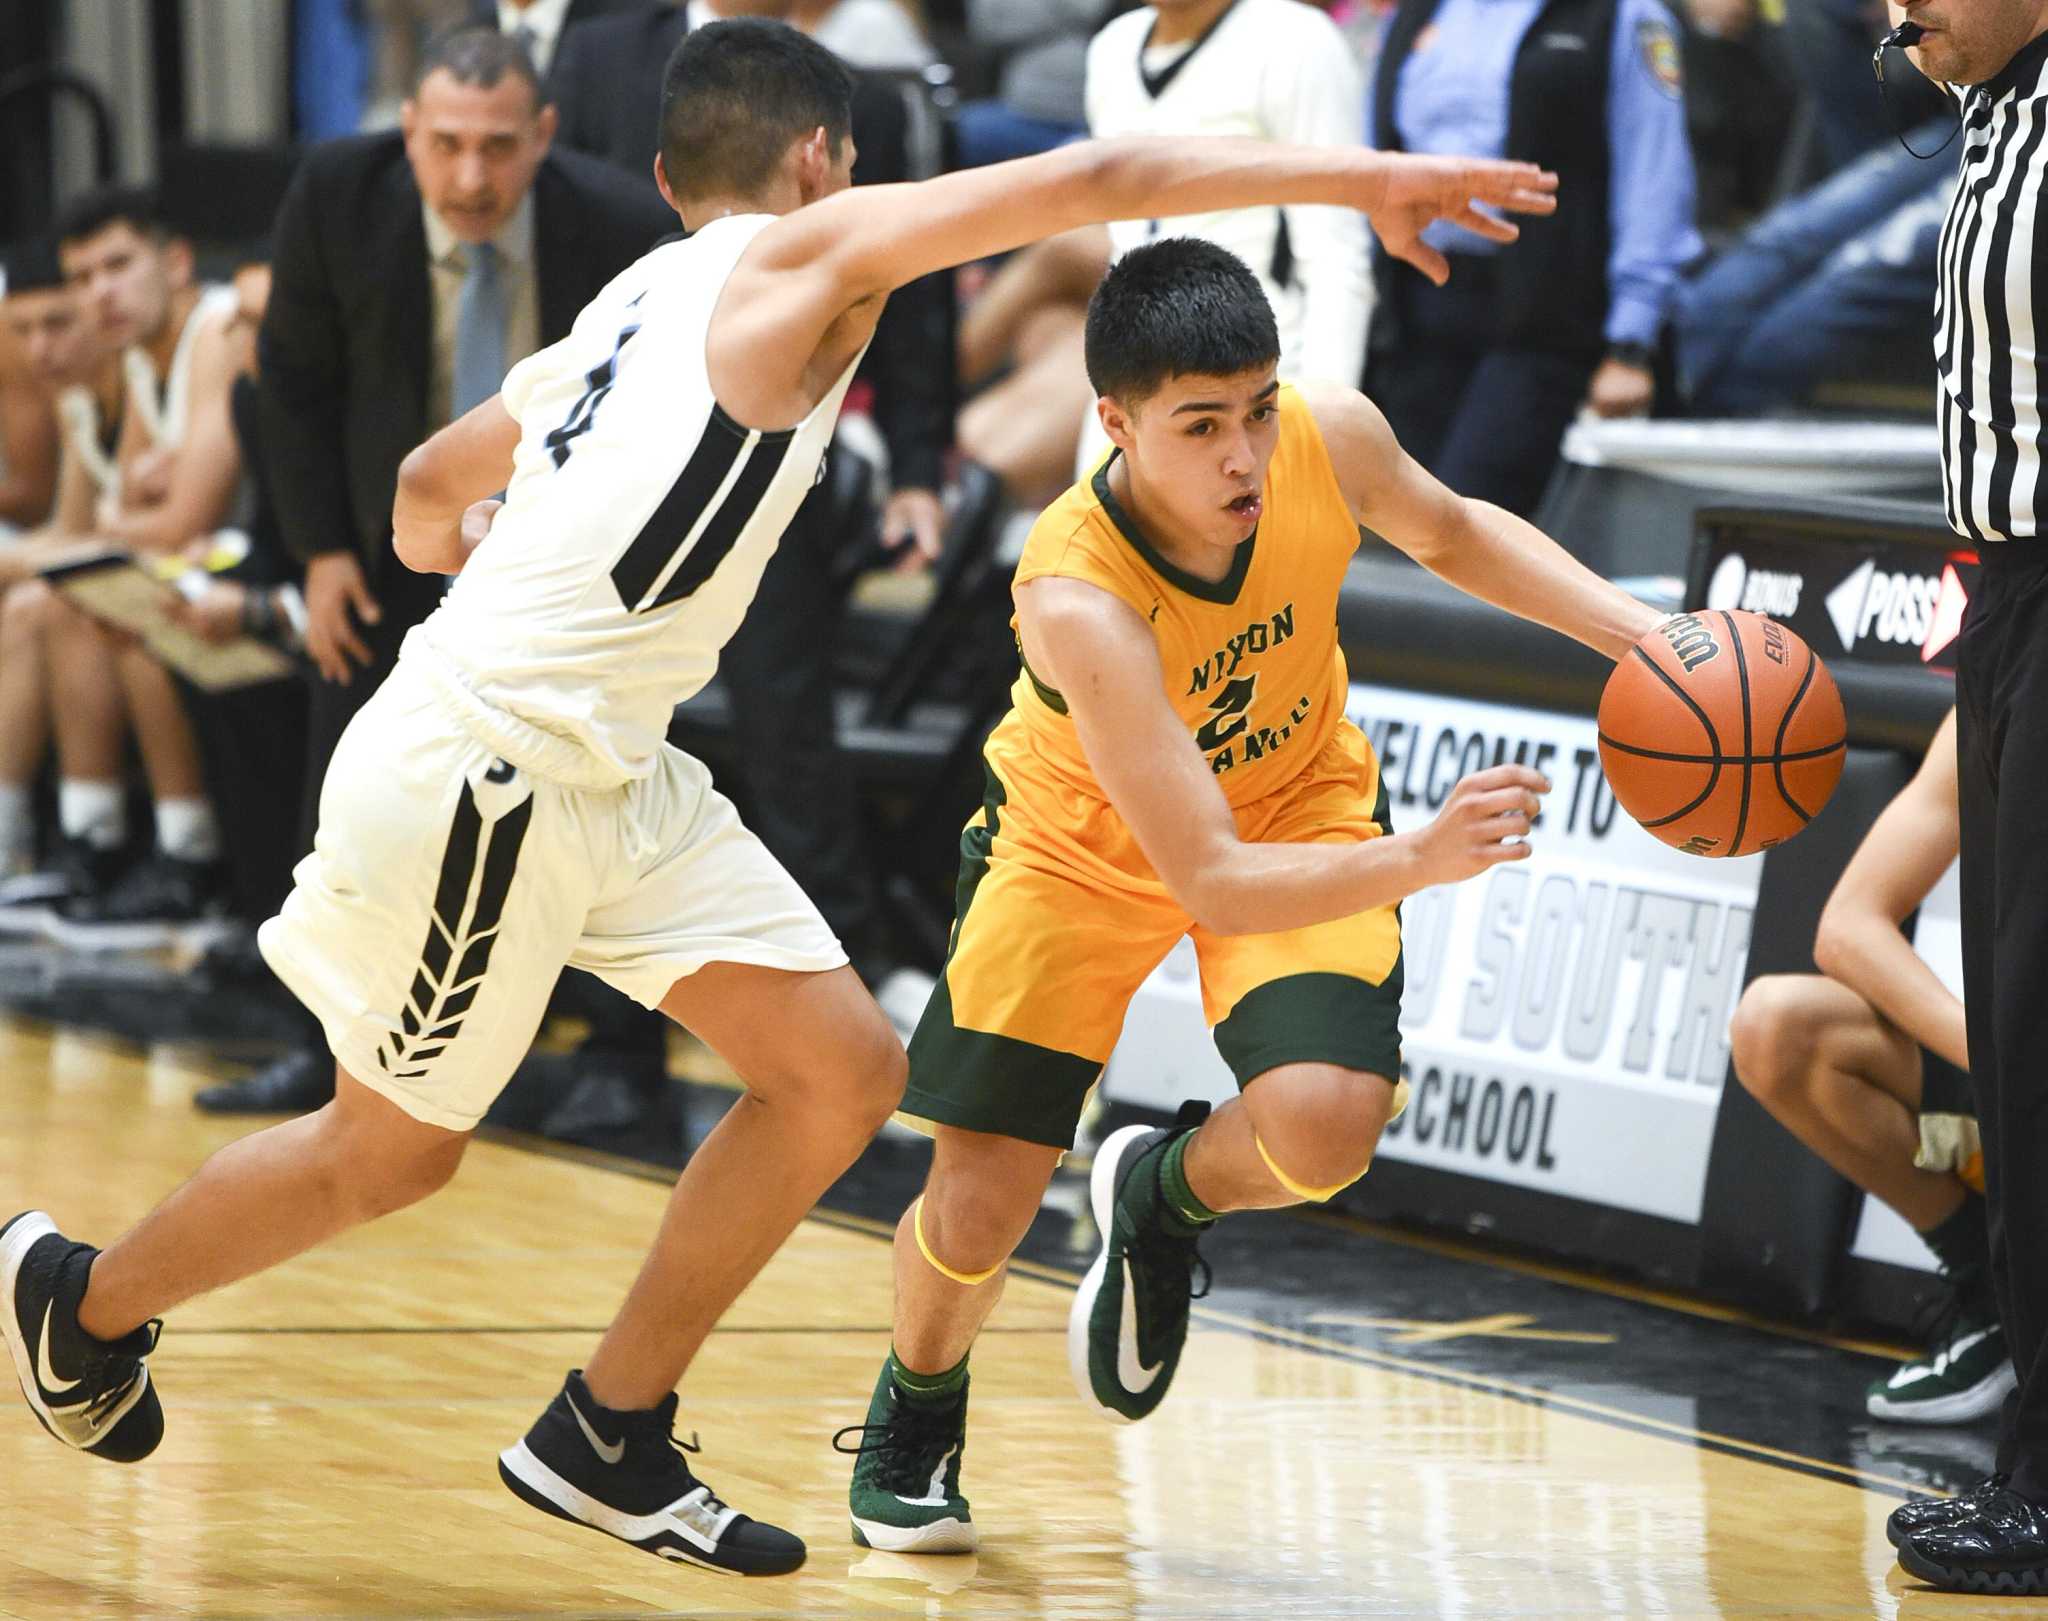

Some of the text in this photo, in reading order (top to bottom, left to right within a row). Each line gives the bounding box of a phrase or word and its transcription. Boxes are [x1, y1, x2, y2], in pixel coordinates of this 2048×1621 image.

[1858, 572, 1941, 645] POSS
[1195, 673, 1257, 752] 2
[1459, 866, 1755, 1087] SOUTH
